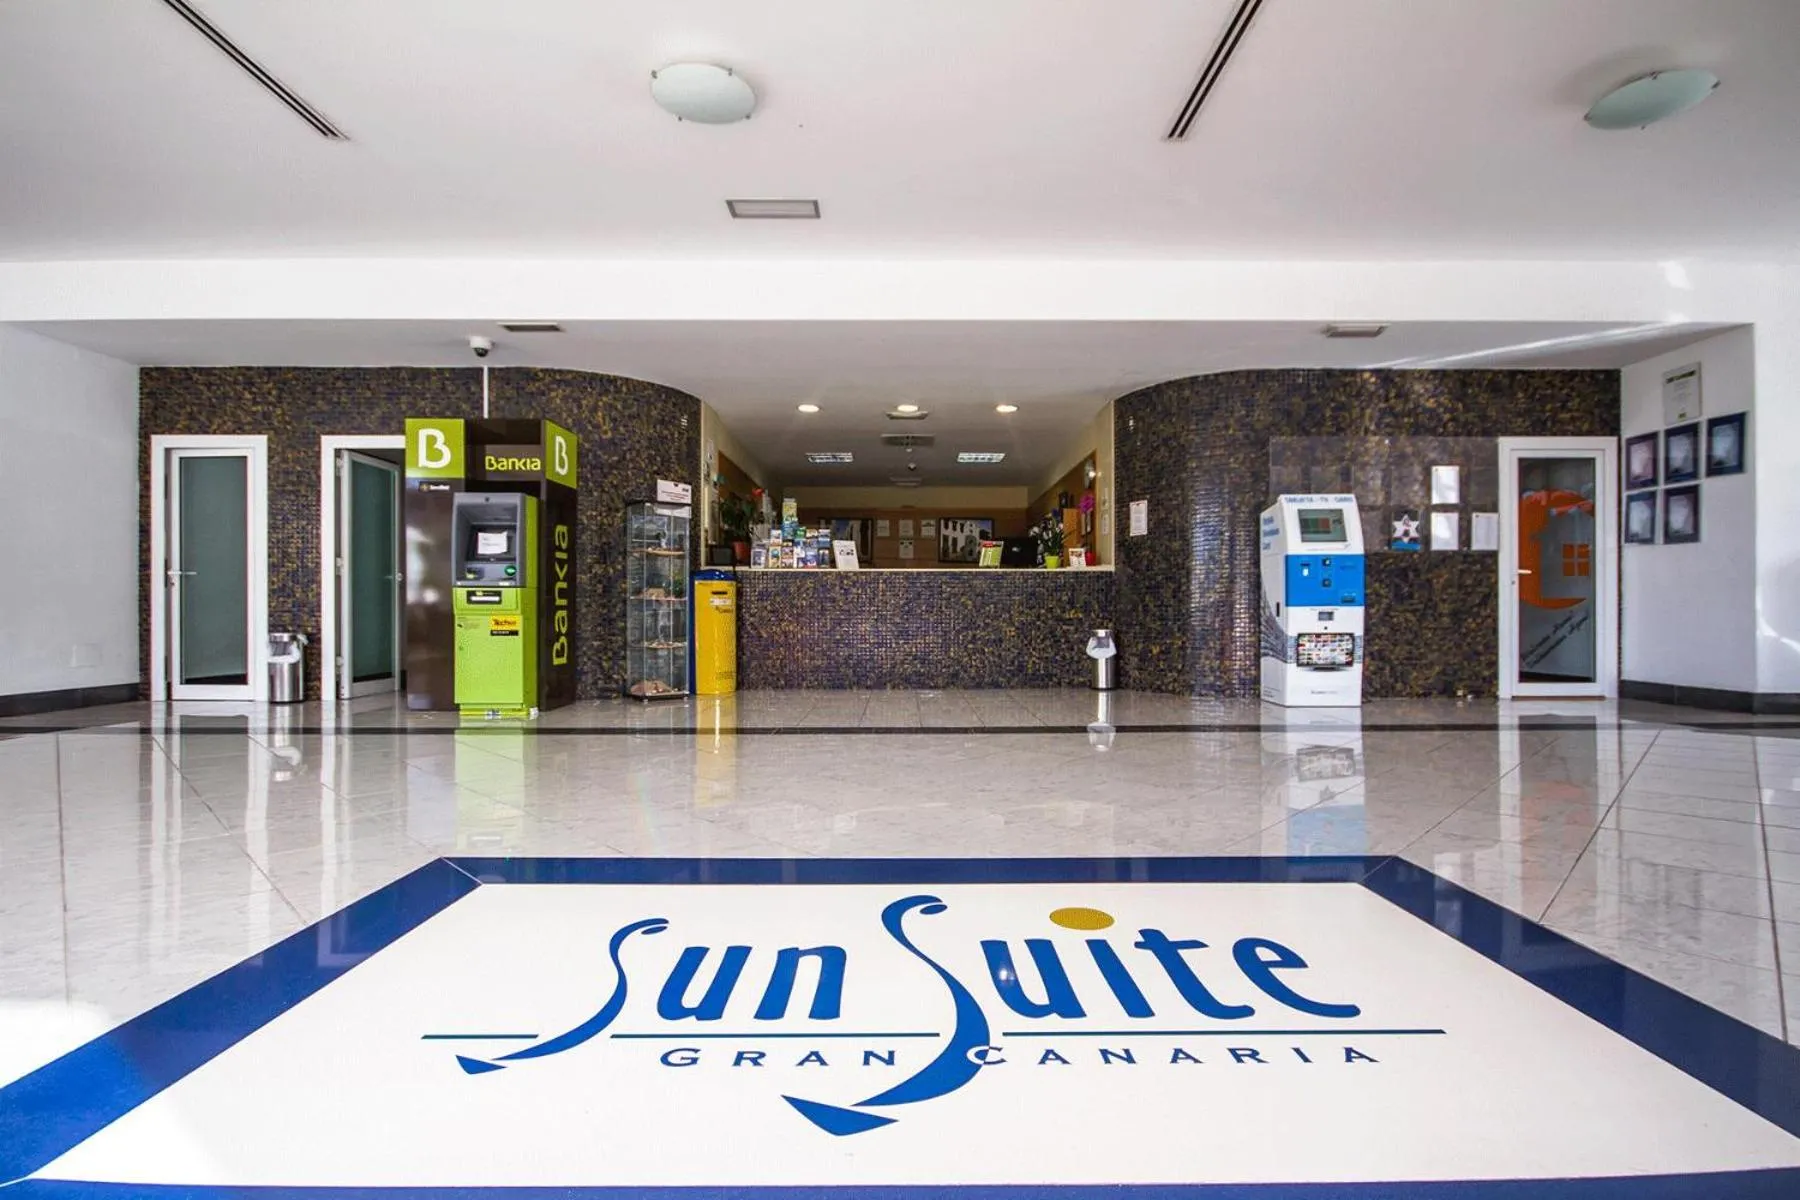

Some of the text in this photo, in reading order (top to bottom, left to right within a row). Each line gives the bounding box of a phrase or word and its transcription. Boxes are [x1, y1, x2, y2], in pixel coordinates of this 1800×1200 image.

[418, 428, 451, 468] B
[485, 456, 541, 471] Bankia
[555, 435, 568, 475] B
[552, 524, 568, 665] Bankia
[660, 1045, 1380, 1067] GRAN CANARIA
